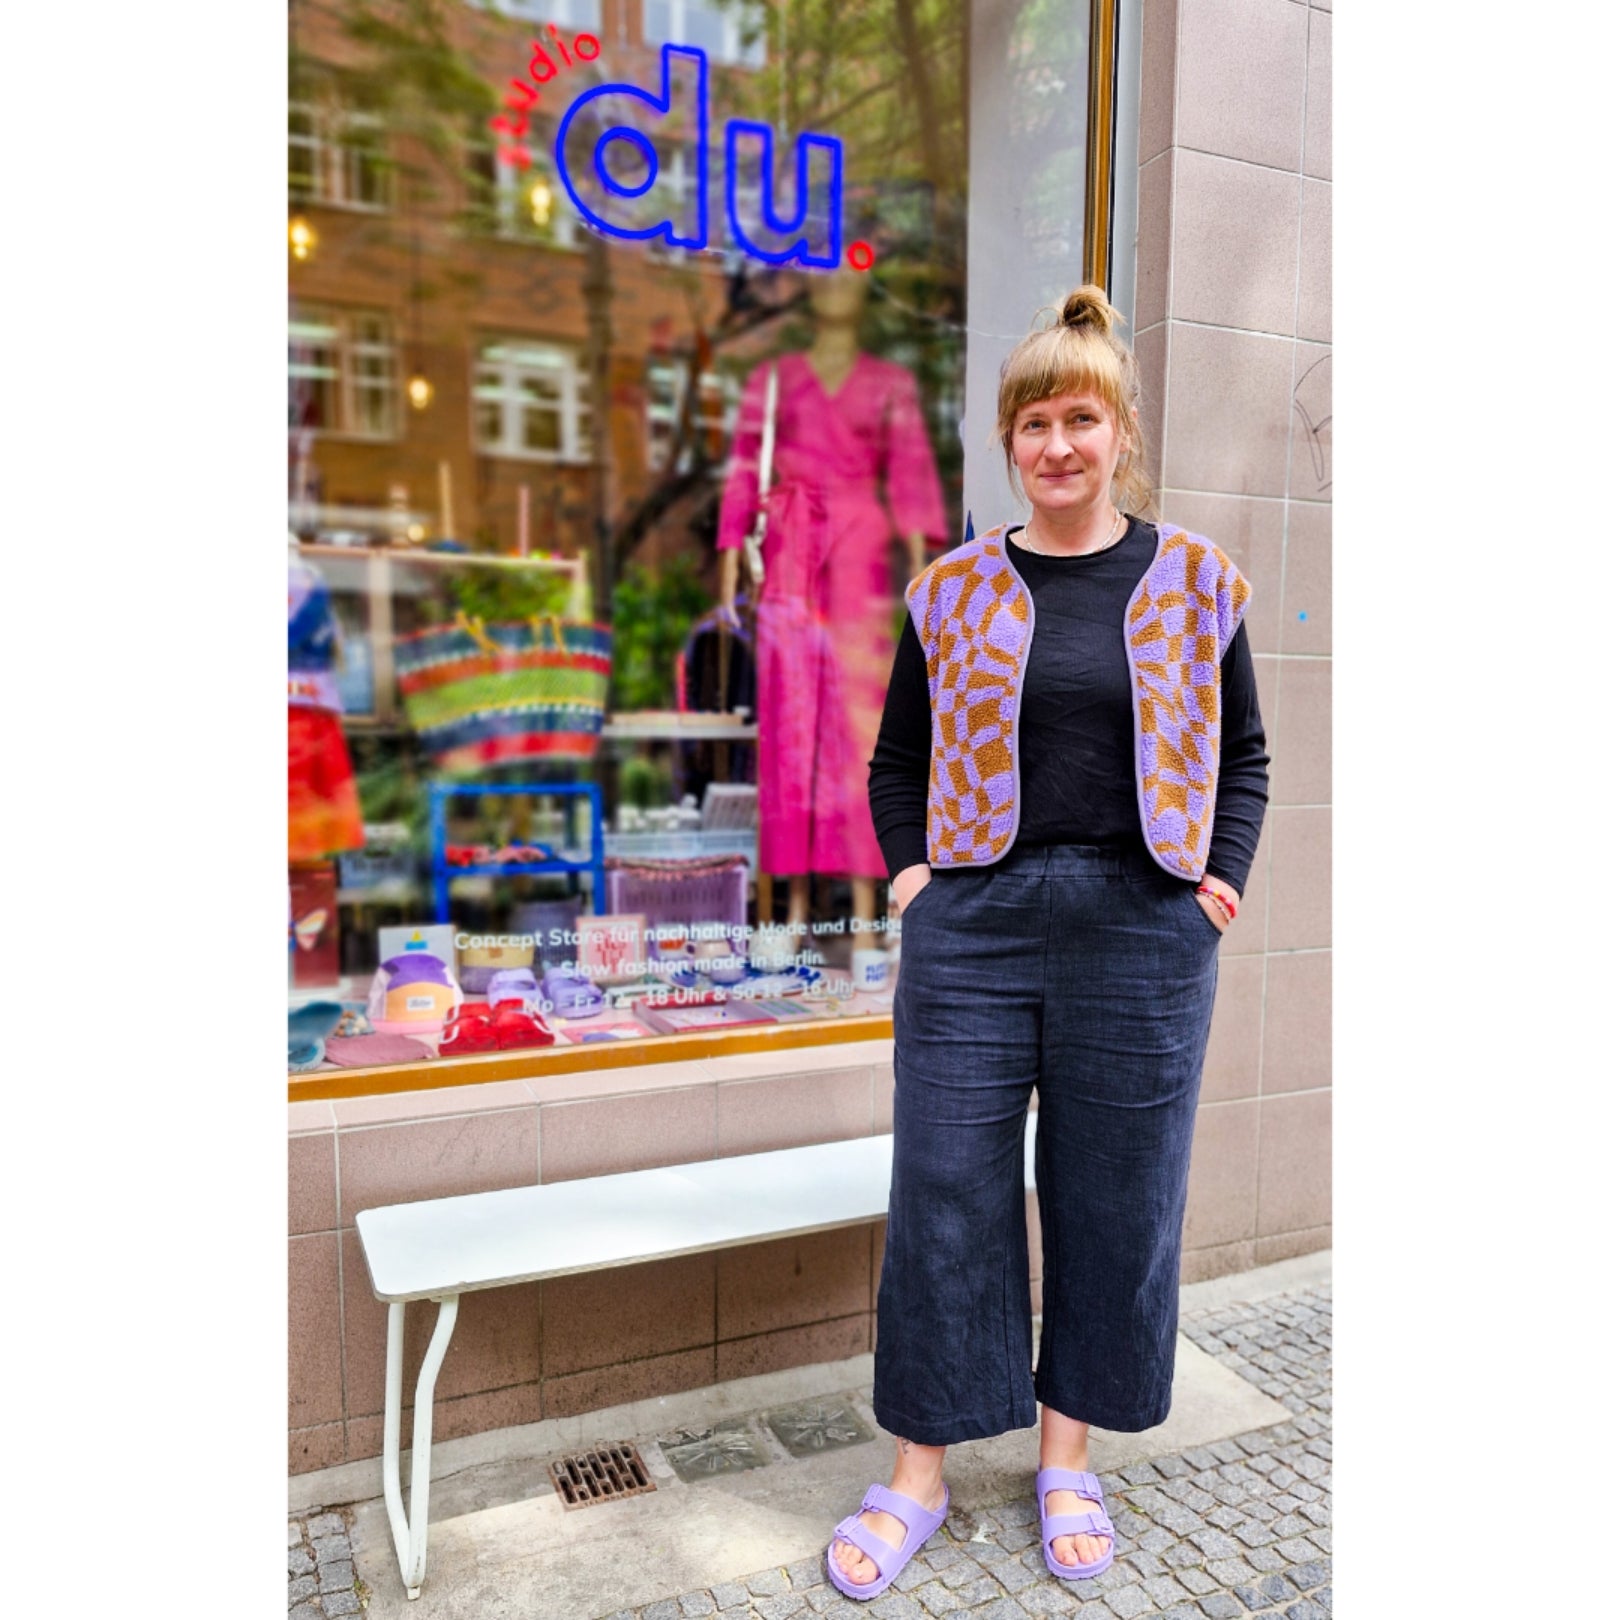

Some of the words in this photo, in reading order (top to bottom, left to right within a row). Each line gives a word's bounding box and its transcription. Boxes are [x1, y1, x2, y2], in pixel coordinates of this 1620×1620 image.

[488, 22, 600, 171] studio
[454, 929, 543, 950] Concept
[549, 927, 607, 946] Store
[643, 920, 753, 944] nachhaltige
[758, 920, 807, 937] Mode
[812, 917, 844, 934] und
[560, 959, 609, 979] Slow
[617, 956, 688, 976] fashion
[695, 953, 745, 972] made
[752, 951, 767, 968] in
[523, 996, 553, 1014] Mo
[575, 993, 594, 1010] Fr
[646, 988, 668, 1006] 18
[674, 985, 706, 1004] Uhr
[713, 985, 727, 1002] &
[828, 976, 857, 995] Uhr
